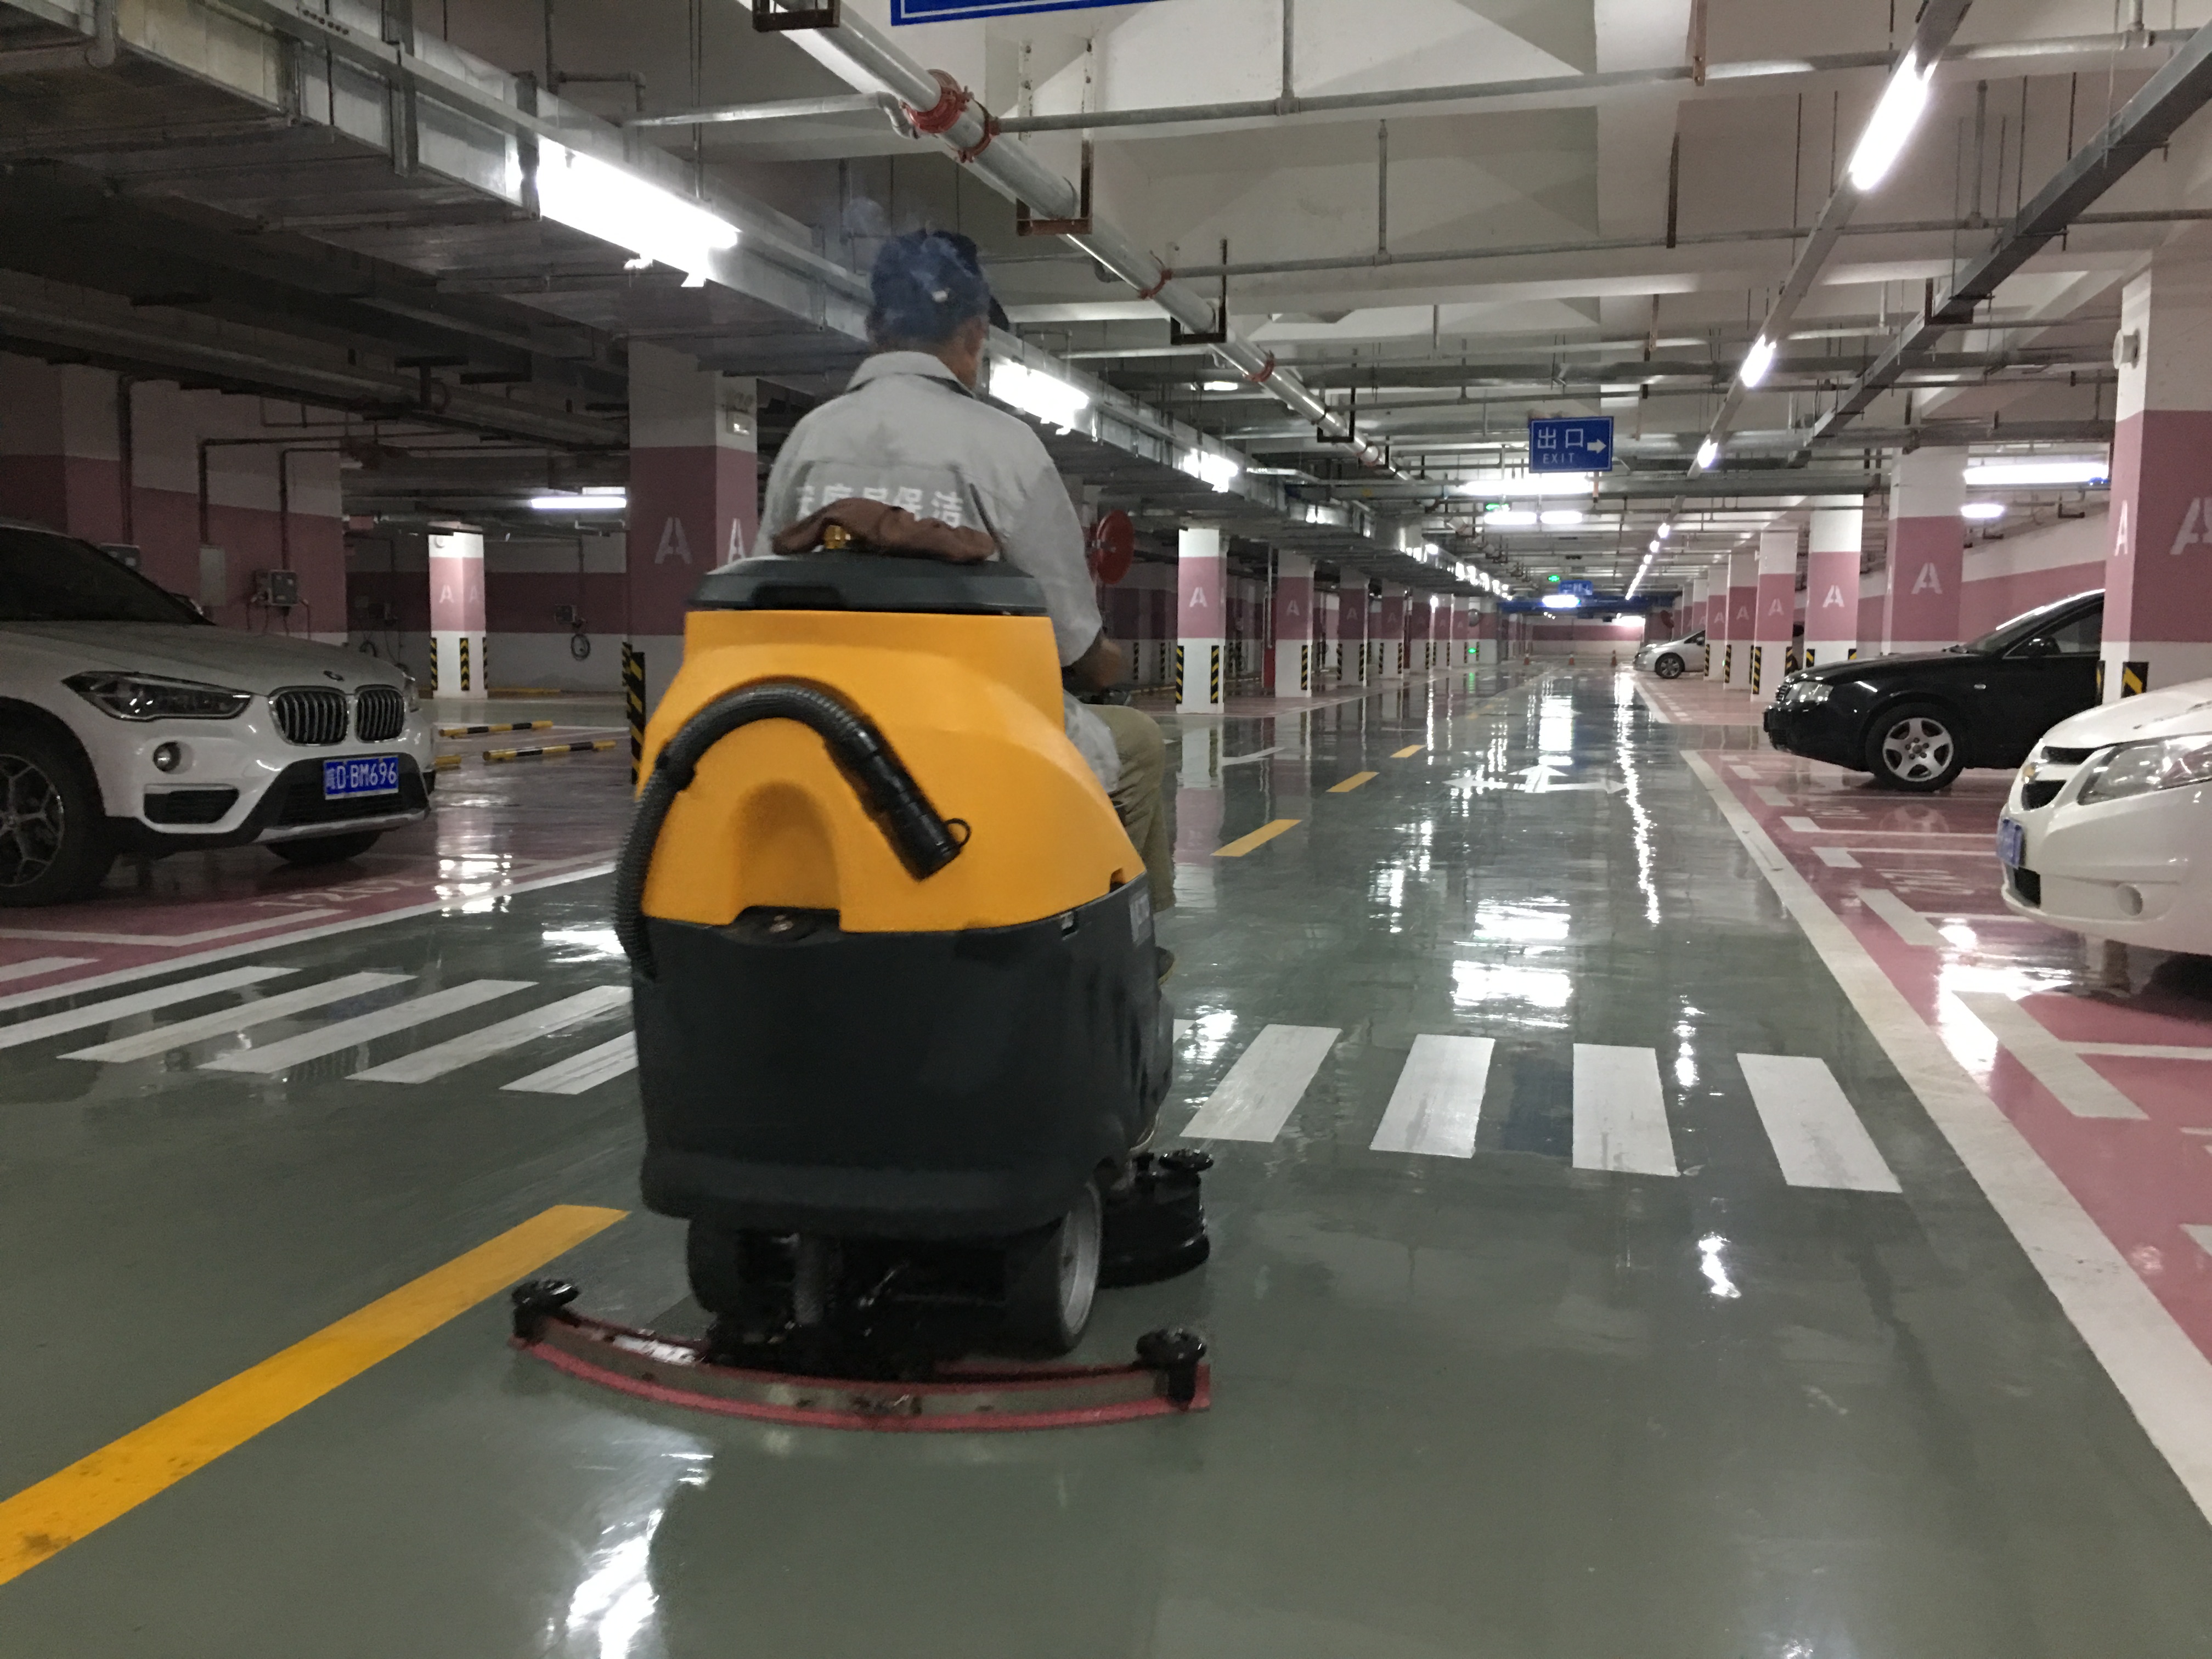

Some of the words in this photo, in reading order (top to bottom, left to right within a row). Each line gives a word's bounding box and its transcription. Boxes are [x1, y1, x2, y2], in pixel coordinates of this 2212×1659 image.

[1538, 427, 1583, 449] 出口
[1543, 453, 1575, 464] EXIT
[2114, 500, 2128, 556] A
[2170, 497, 2212, 555] A
[654, 517, 692, 565] A
[728, 518, 746, 564] A
[1911, 562, 1943, 595] A
[439, 585, 454, 603] A
[470, 586, 480, 603] A
[1189, 587, 1207, 607] A
[1822, 585, 1845, 607] A
[1286, 600, 1300, 616] A
[1346, 607, 1358, 620] A
[1736, 606, 1749, 620] A
[1768, 599, 1784, 616] A
[1387, 612, 1396, 623] A
[1714, 612, 1725, 623] A
